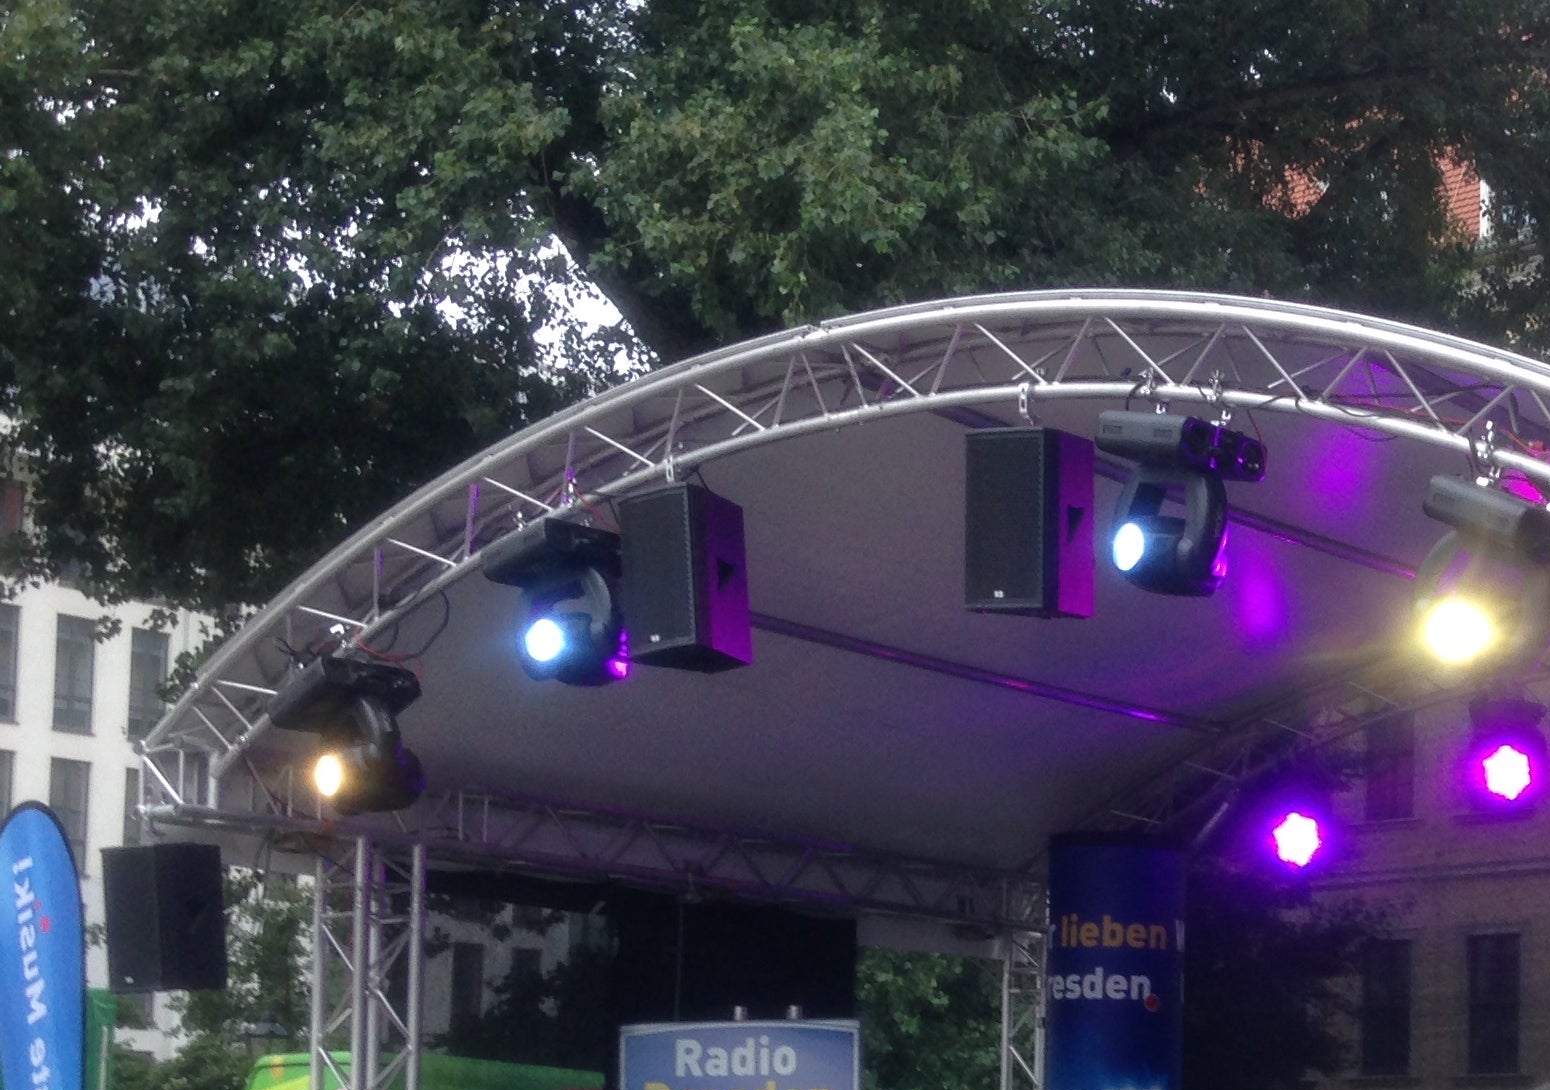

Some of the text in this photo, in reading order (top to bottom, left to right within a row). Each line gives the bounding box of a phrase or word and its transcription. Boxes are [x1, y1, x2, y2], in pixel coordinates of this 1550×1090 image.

[1061, 913, 1168, 950] lieben
[1048, 966, 1153, 1001] esden
[674, 1034, 798, 1078] Radio
